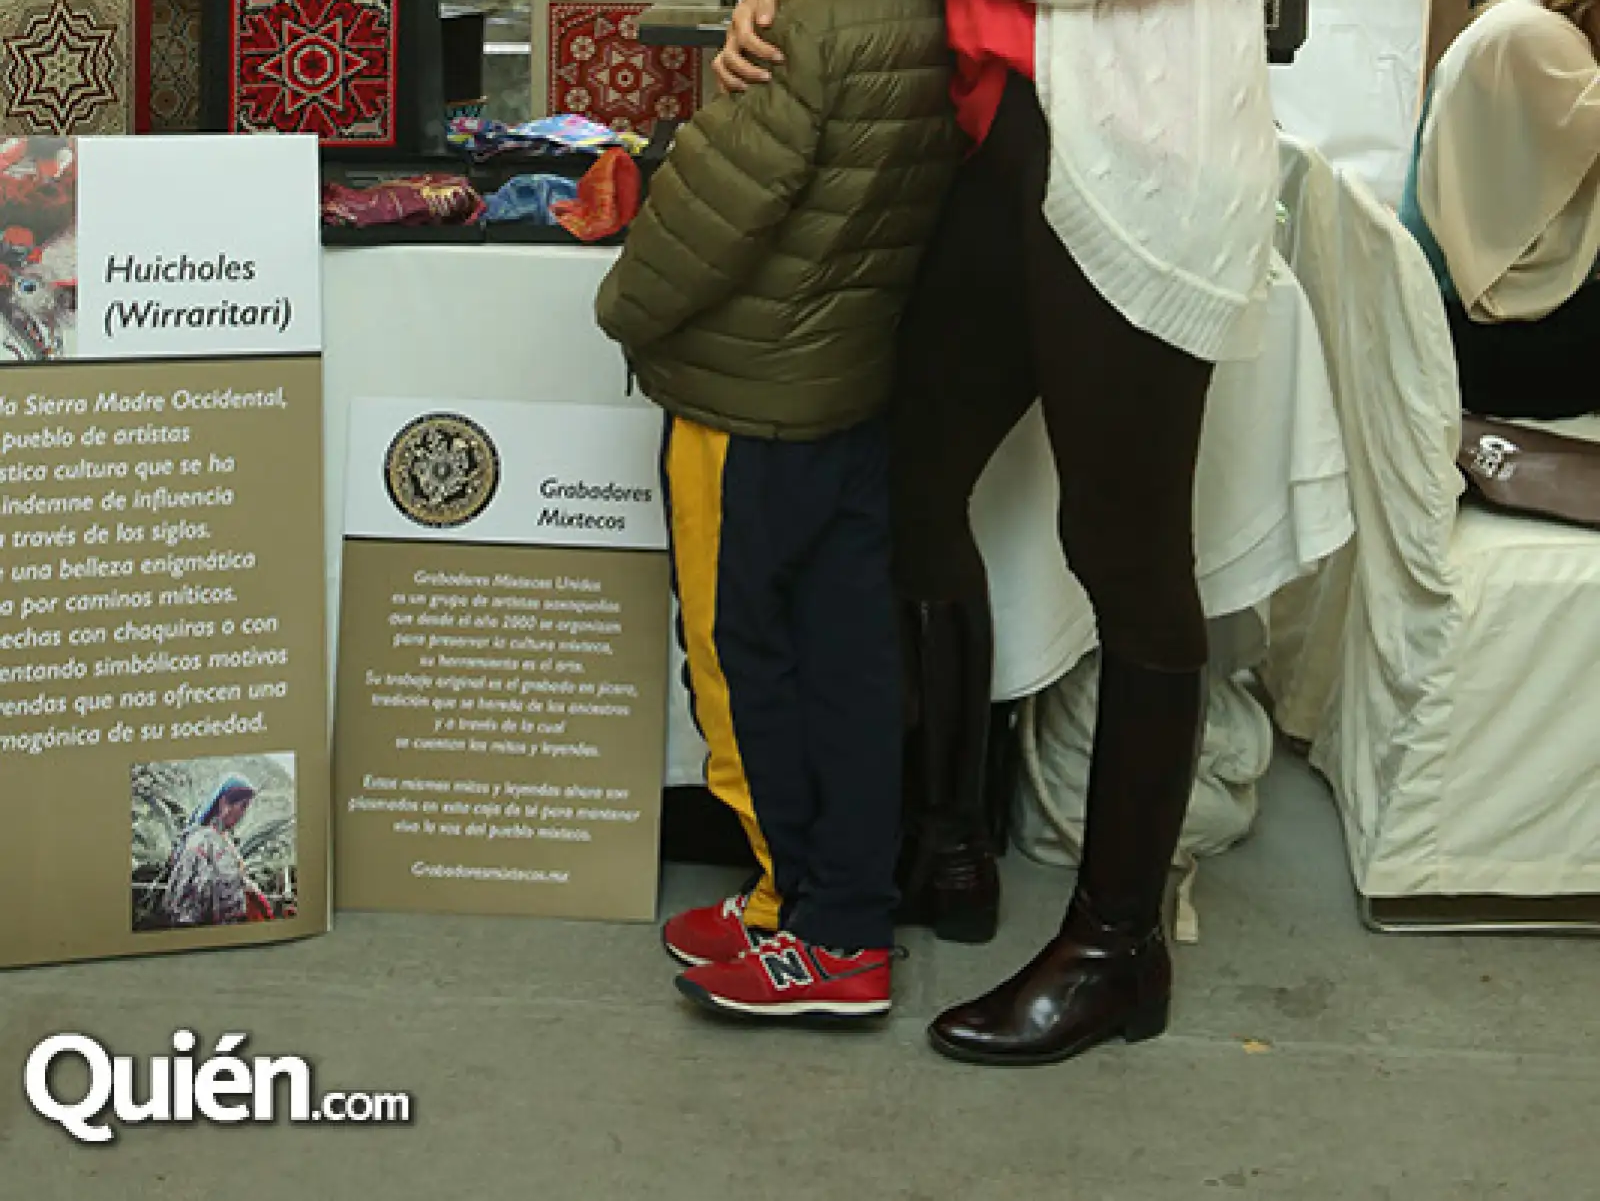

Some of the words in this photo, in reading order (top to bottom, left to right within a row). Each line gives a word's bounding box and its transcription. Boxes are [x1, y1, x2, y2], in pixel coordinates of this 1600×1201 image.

[104, 252, 256, 283] Huicholes
[104, 297, 293, 337] (Wirraritari)
[24, 393, 87, 415] Sierra
[94, 391, 165, 412] Madre
[171, 386, 288, 410] Occidental,
[2, 426, 75, 453] pueblo
[81, 425, 106, 446] de
[113, 423, 191, 445] artistas
[54, 458, 128, 480] cultura
[135, 458, 174, 481] que
[180, 457, 201, 475] se
[207, 453, 236, 473] ha
[2, 493, 94, 515] indemne
[101, 488, 126, 511] de
[132, 486, 235, 513] influencia
[539, 477, 652, 502] Grabadores
[12, 526, 76, 547] través
[84, 523, 109, 544] de
[116, 522, 145, 543] los
[152, 519, 211, 547] siglos.
[537, 508, 625, 530] Mixtecos
[12, 562, 52, 581] una
[60, 556, 133, 579] belleza
[140, 550, 256, 578] enigmática
[20, 596, 59, 619] por
[65, 589, 153, 612] caminos
[158, 585, 238, 606] míticos.
[429, 594, 467, 609] grupo
[469, 594, 487, 608] de
[492, 596, 541, 609] artistas
[69, 627, 107, 644] con
[113, 619, 215, 644] chaquiras
[222, 619, 235, 634] o
[240, 616, 279, 634] con
[417, 612, 454, 627] desde
[458, 614, 471, 626] el
[474, 614, 498, 628] año
[509, 636, 556, 650] cultura
[93, 652, 202, 676] simbólicos
[207, 646, 289, 668] motivos
[540, 657, 553, 671] el
[386, 673, 433, 688] trabajo
[436, 675, 487, 692] original
[507, 678, 519, 691] el
[521, 679, 575, 695] grabado
[73, 693, 113, 717] que
[119, 689, 156, 708] nos
[162, 682, 241, 709] ofrecen
[248, 681, 288, 699] una
[432, 697, 457, 711] que
[527, 699, 543, 713] de
[107, 720, 134, 742] de
[140, 722, 164, 741] su
[170, 711, 267, 739] sociedad.
[458, 718, 498, 732] través
[501, 718, 519, 733] de
[537, 719, 566, 734] cual
[504, 782, 559, 798] leyendas
[504, 803, 520, 818] de
[540, 805, 574, 821] para
[465, 821, 487, 836] del
[488, 823, 535, 840] pueblo
[758, 948, 814, 991] N
